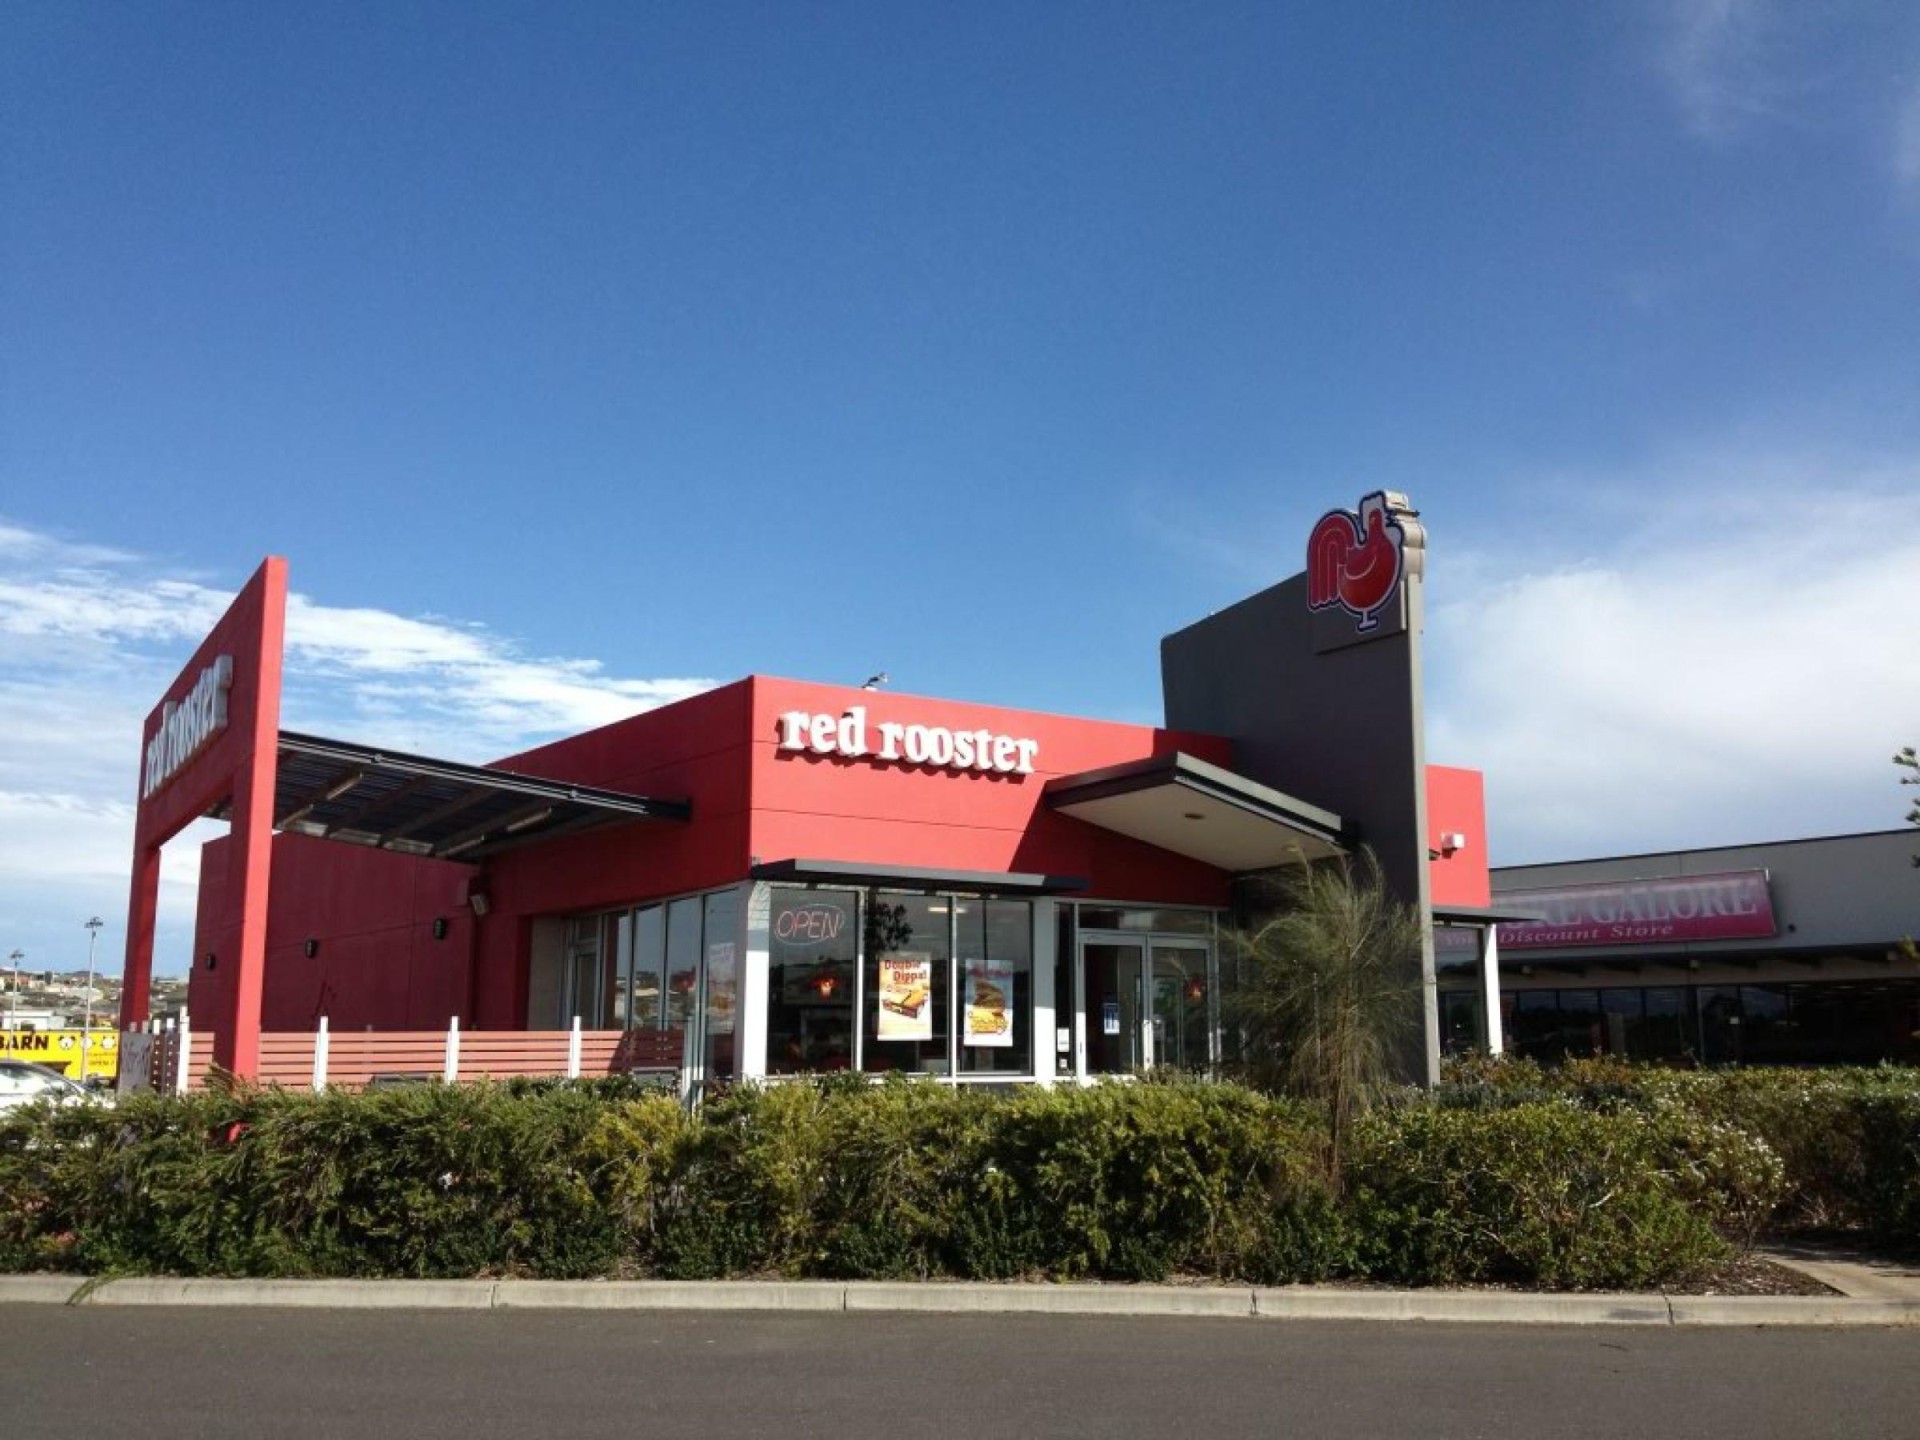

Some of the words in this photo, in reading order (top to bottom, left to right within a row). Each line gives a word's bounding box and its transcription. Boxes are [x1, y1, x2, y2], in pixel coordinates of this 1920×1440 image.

[779, 706, 867, 757] red
[876, 722, 1039, 774] rooster
[1588, 879, 1758, 924] GALORE
[777, 910, 840, 939] OPEN
[1499, 926, 1600, 944] Discount
[1611, 923, 1675, 938] Store
